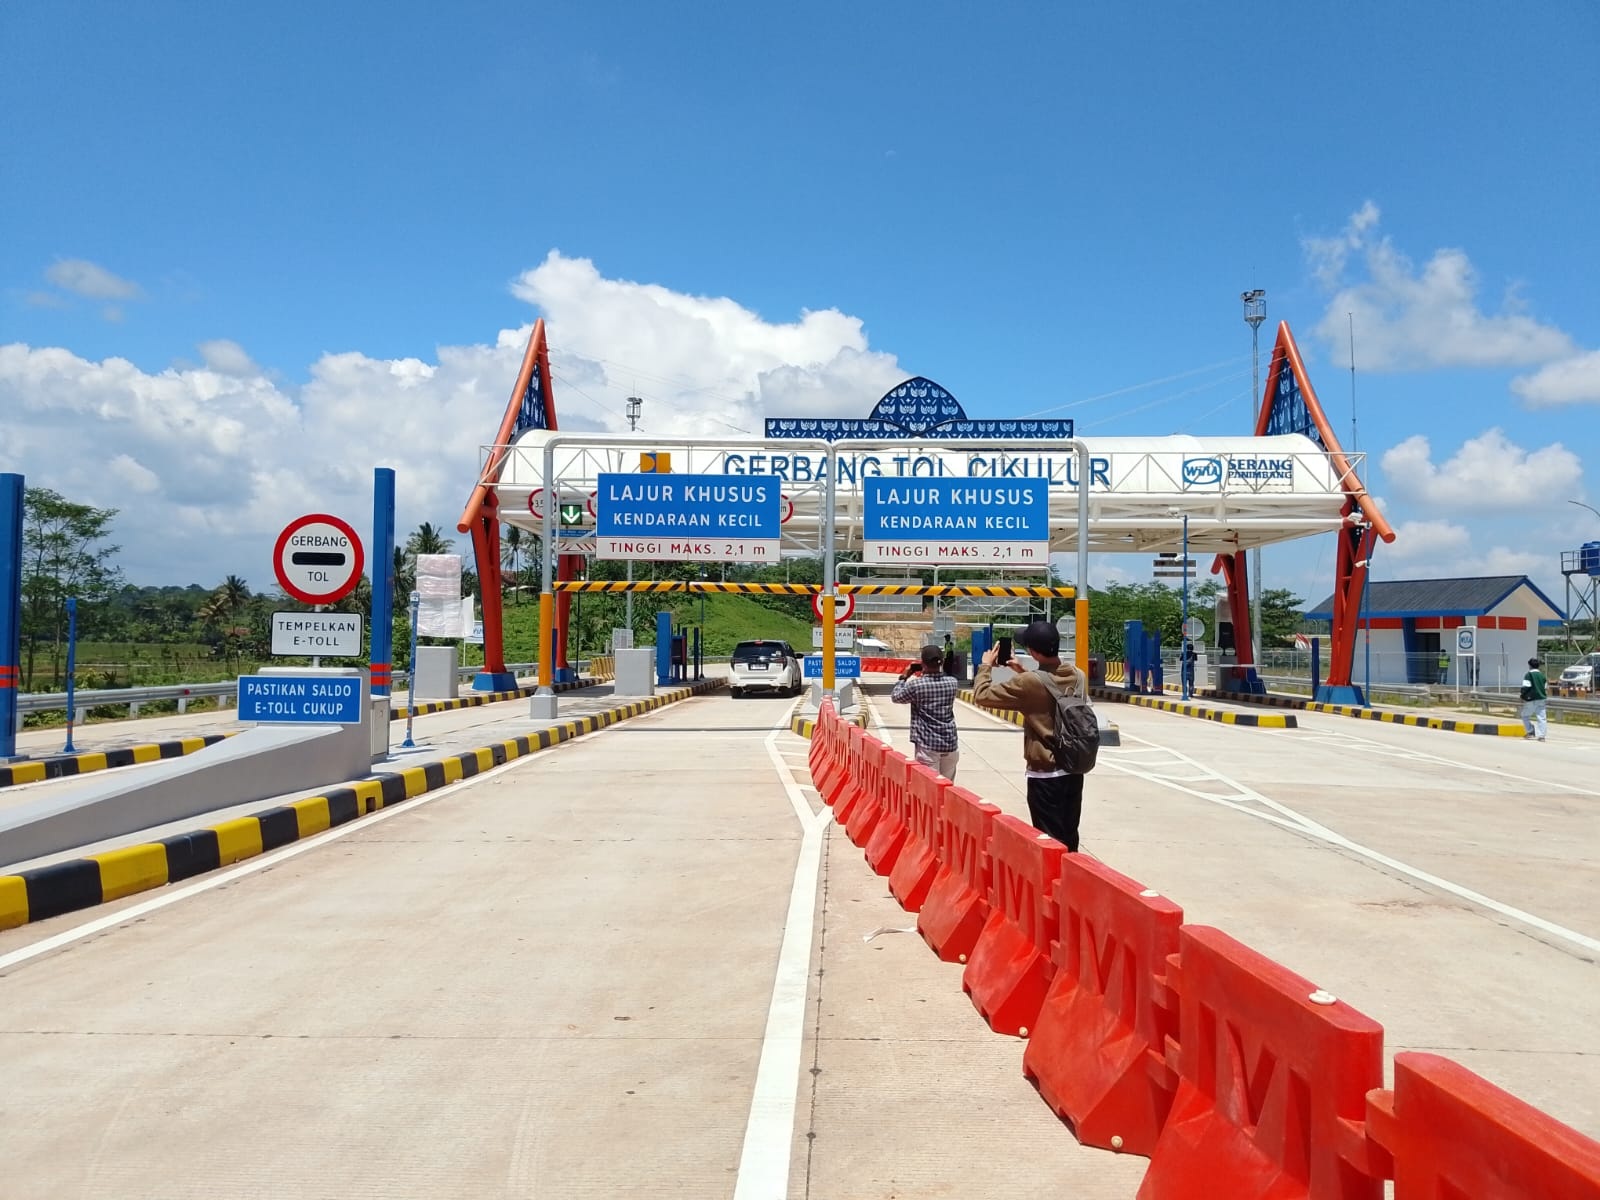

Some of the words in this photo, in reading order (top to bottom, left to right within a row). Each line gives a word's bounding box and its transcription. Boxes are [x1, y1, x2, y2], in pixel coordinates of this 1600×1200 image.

[724, 455, 880, 484] GERBANG
[1228, 459, 1292, 470] SERANG
[1228, 471, 1292, 479] PANIMBANG
[610, 485, 673, 502] LAJUR
[684, 486, 767, 503] KHUSUS
[876, 488, 940, 505] LAJUR
[951, 489, 1034, 505] KHUSUS
[613, 513, 710, 527] KENDARAAN
[718, 515, 762, 527] KECIL
[880, 515, 977, 529] KENDARAAN
[985, 517, 1030, 529] KECIL
[291, 535, 348, 548] GERBANG
[609, 543, 661, 554] TINGGI
[671, 543, 716, 555] MAKS.
[725, 544, 744, 556] 2,1
[753, 546, 765, 555] m
[877, 546, 929, 557] TINGGI
[938, 546, 985, 557] MAKS.
[993, 546, 1011, 558] 2,1
[1021, 548, 1033, 557] m
[307, 571, 329, 582] TOL
[278, 621, 355, 632] TEMPELKAN
[293, 636, 339, 646] E-TOLL
[247, 684, 305, 696] PASTIKAN
[312, 684, 351, 697] SALDO
[255, 702, 297, 715] E-TOLL
[302, 703, 343, 715] CUKUP
